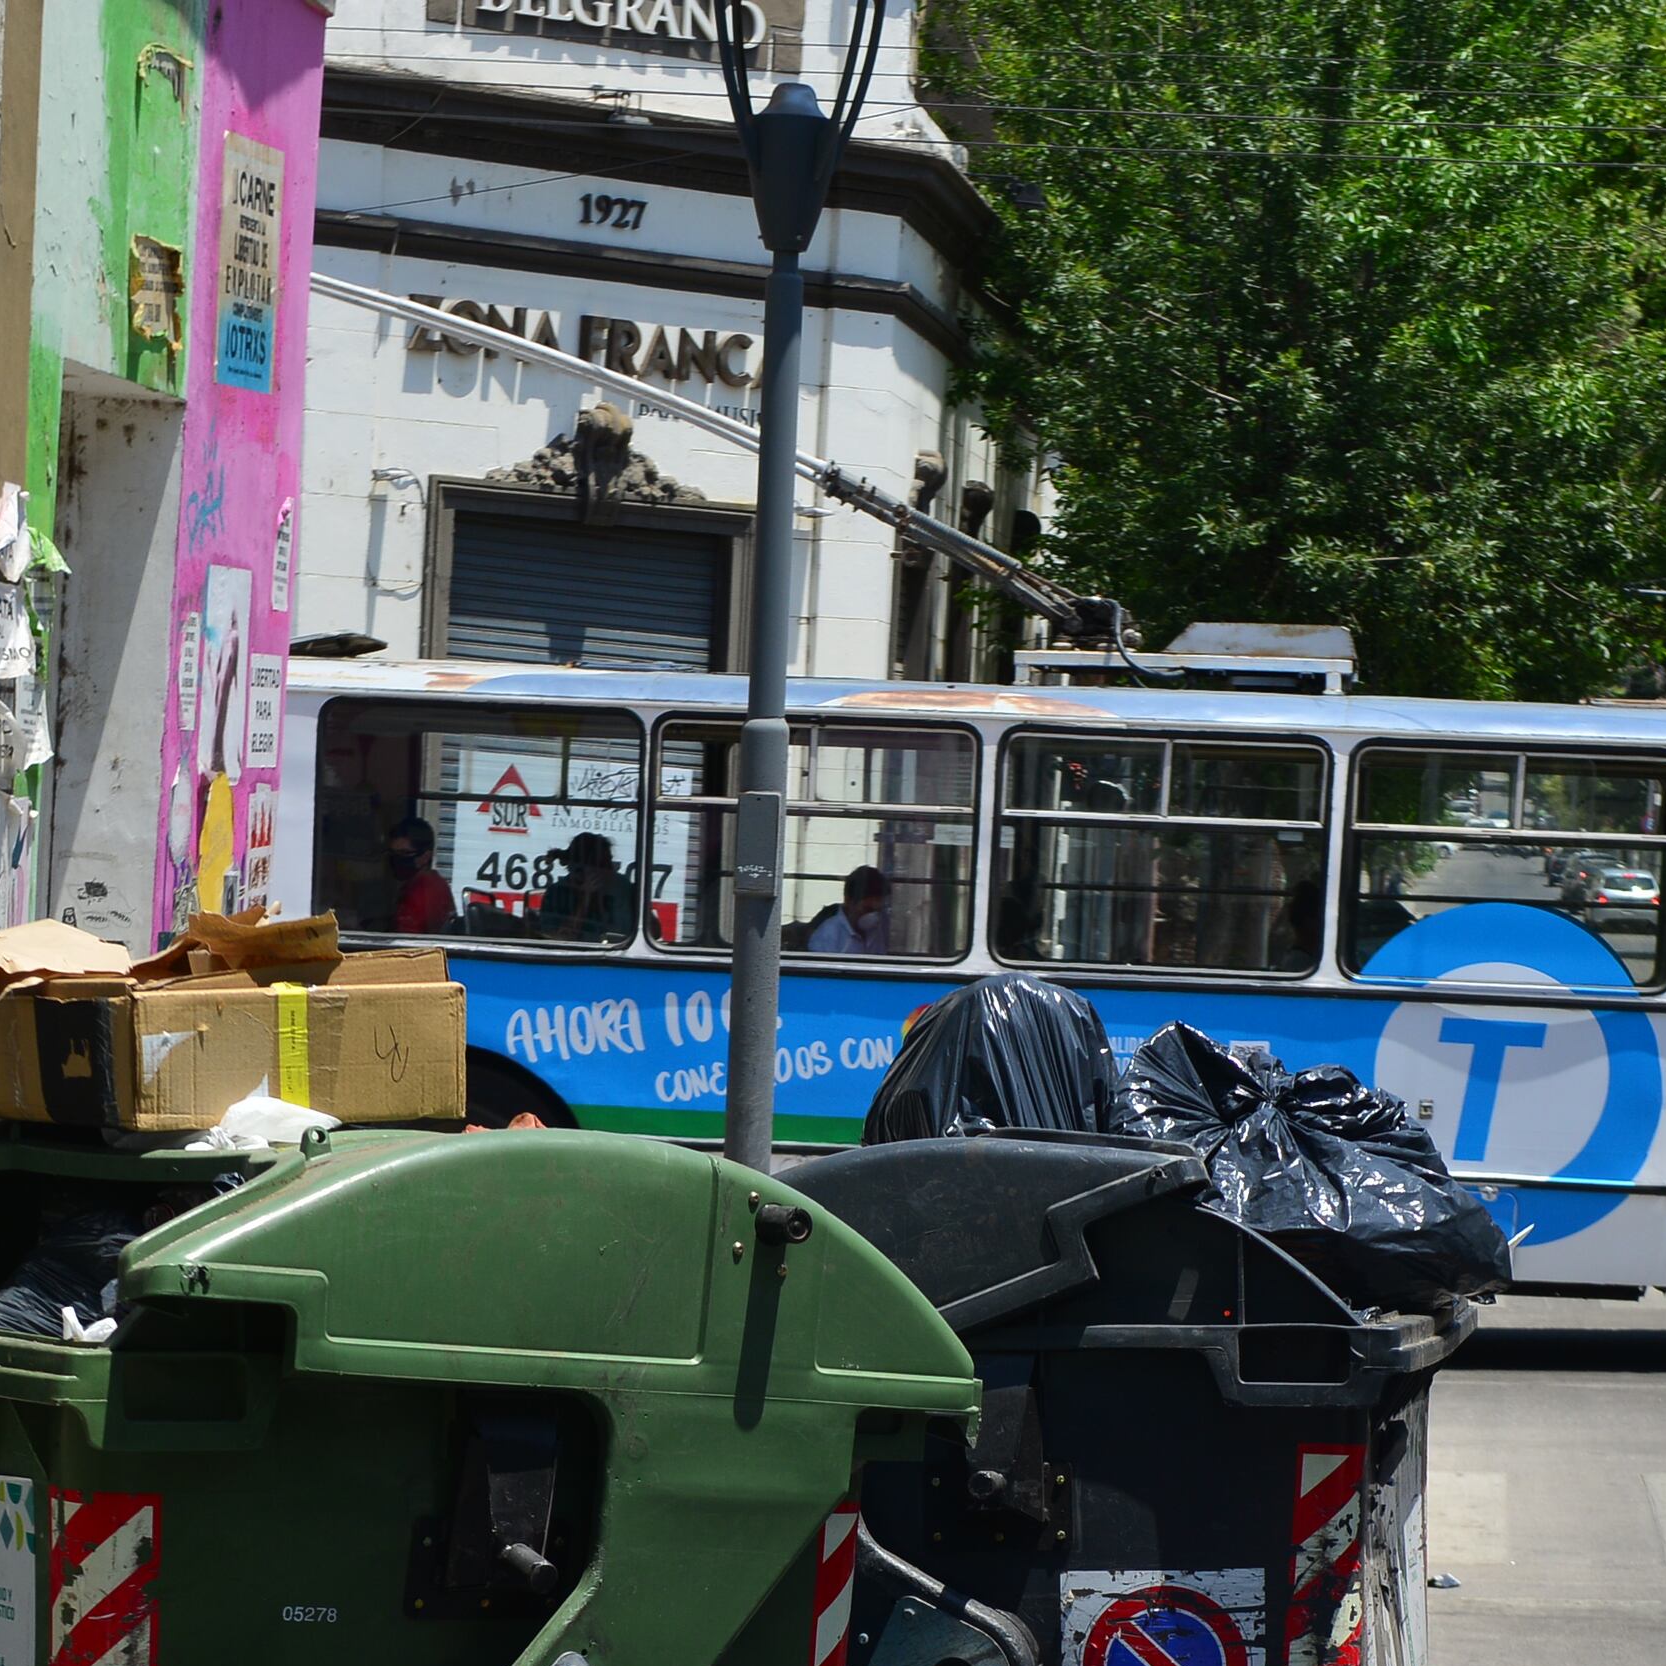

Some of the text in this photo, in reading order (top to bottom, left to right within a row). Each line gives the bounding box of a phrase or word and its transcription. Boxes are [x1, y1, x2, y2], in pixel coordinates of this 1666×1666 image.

[239, 171, 276, 217] CARNE
[579, 193, 648, 230] 1927
[492, 801, 528, 829] SUR
[506, 998, 646, 1064] AHORA
[839, 1034, 895, 1071] CON
[1439, 1017, 1548, 1162] T
[282, 1606, 337, 1623] 05278
